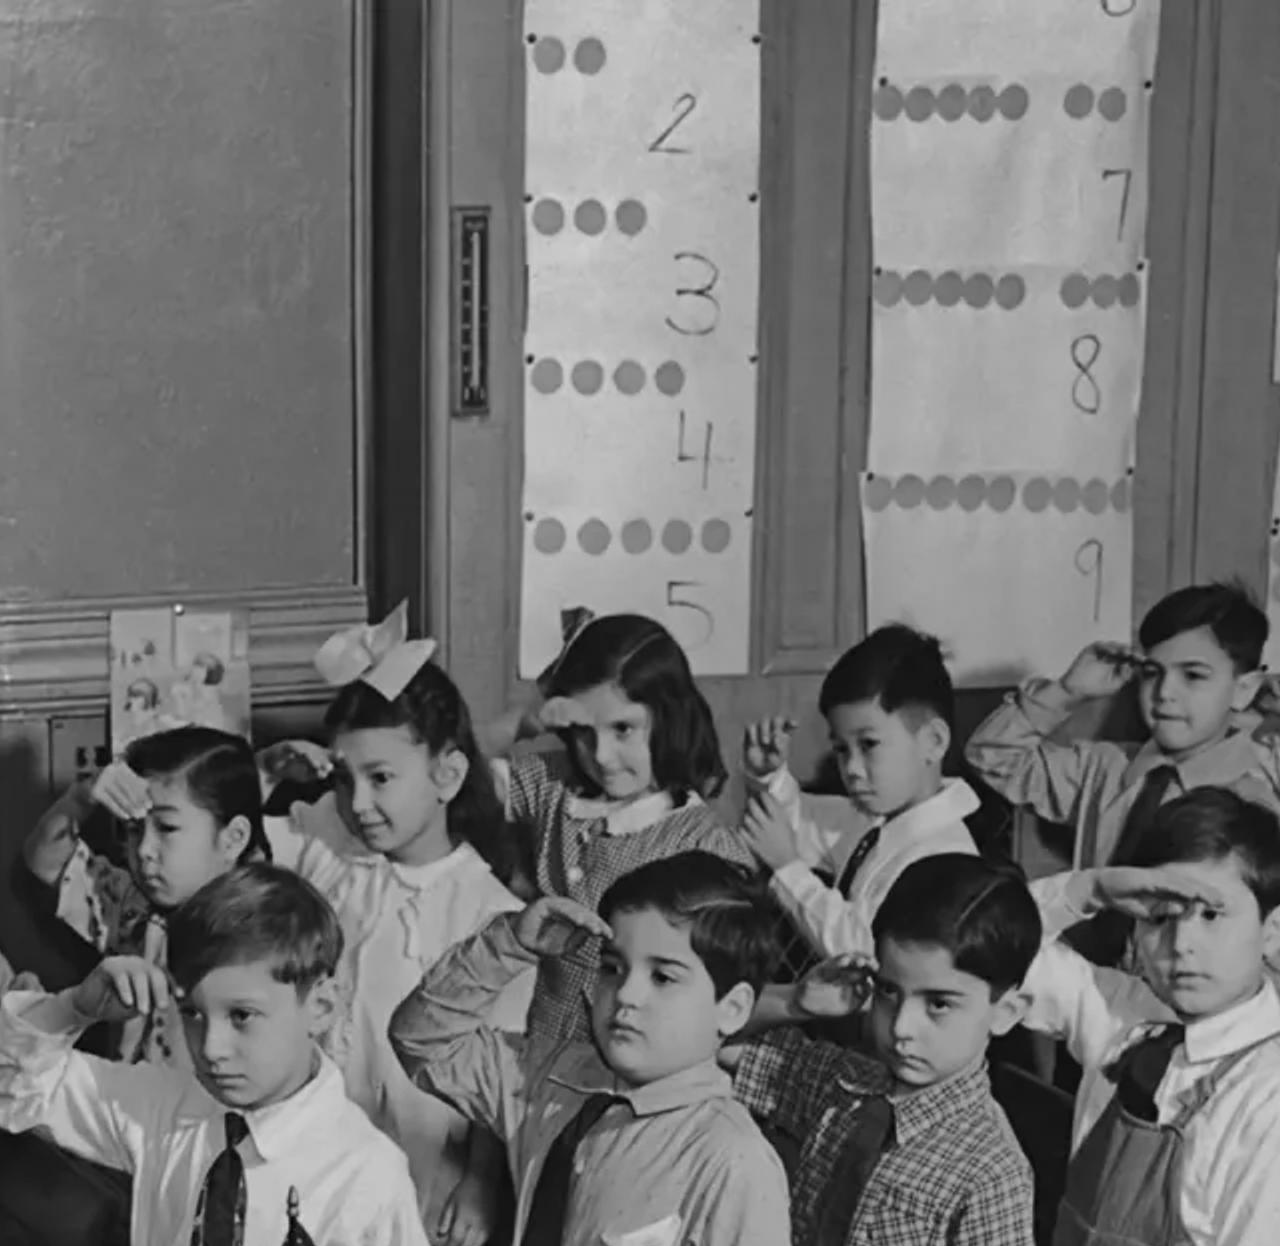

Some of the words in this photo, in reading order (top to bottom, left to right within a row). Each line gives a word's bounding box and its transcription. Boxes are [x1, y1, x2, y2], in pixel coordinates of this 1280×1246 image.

[648, 93, 696, 154] 2
[1101, 168, 1132, 242] 7
[665, 252, 720, 337] 3
[1070, 334, 1102, 415] 8
[677, 409, 733, 491] 4
[666, 580, 714, 651] 5
[1074, 538, 1104, 622] 9
